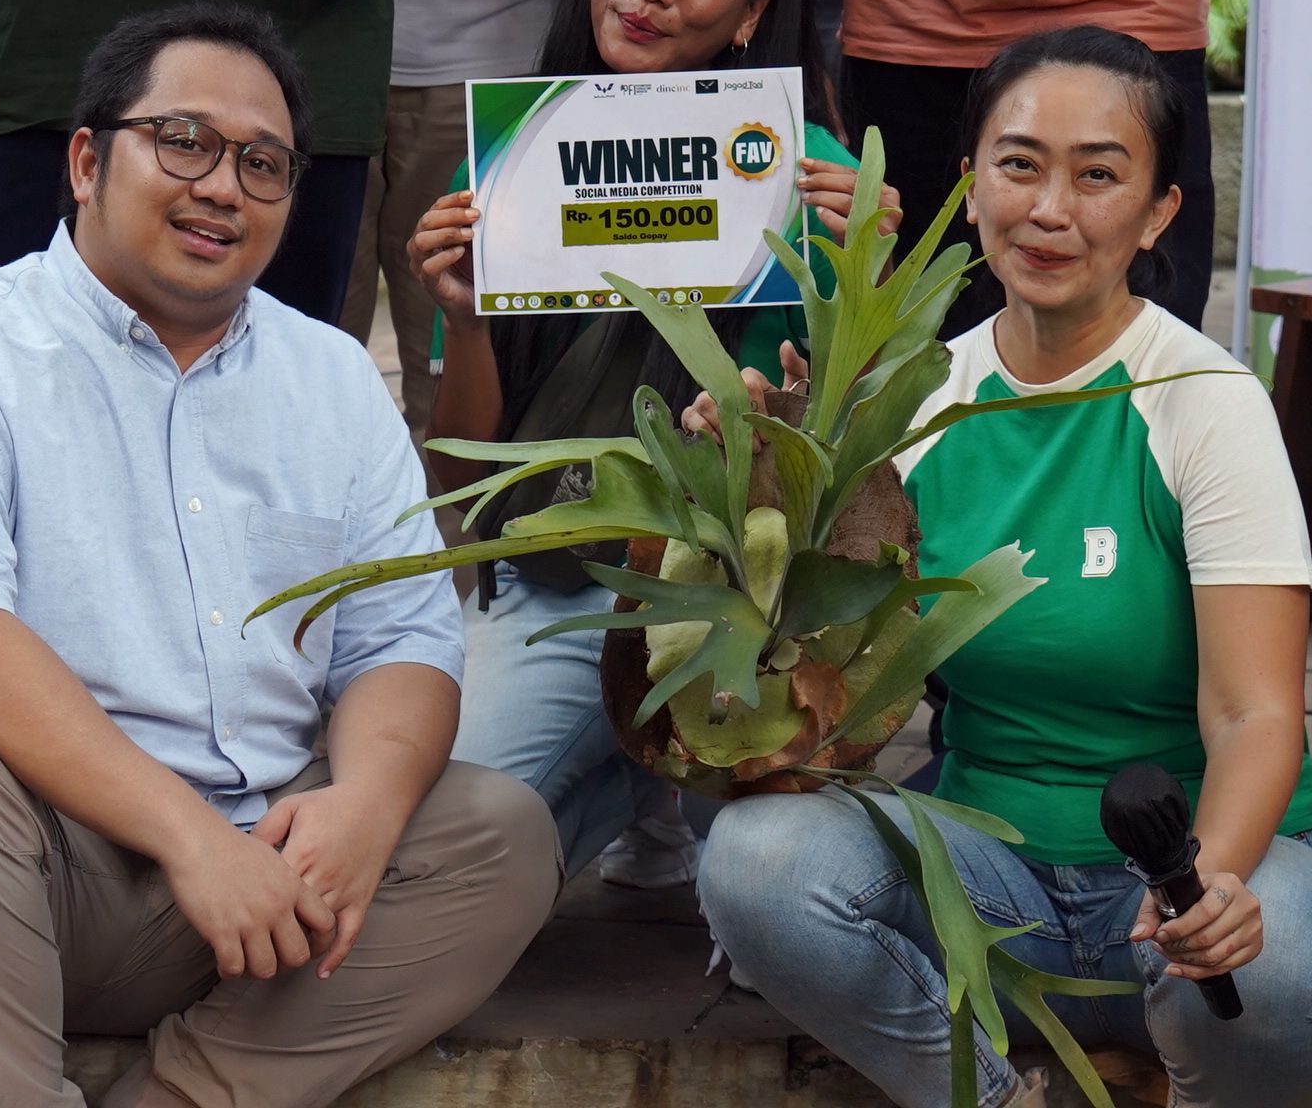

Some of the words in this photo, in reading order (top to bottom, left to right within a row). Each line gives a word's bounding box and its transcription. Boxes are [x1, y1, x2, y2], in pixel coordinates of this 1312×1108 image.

[558, 136, 718, 185] WINNER
[736, 141, 774, 164] FAV
[575, 187, 608, 198] SOCIAL
[610, 186, 638, 197] MEDIA
[640, 183, 702, 196] COMPETITION
[566, 210, 592, 223] Rp.
[599, 205, 713, 228] 150.000
[613, 232, 637, 241] Saldo
[640, 232, 667, 241] Gopay
[1081, 526, 1118, 578] B
